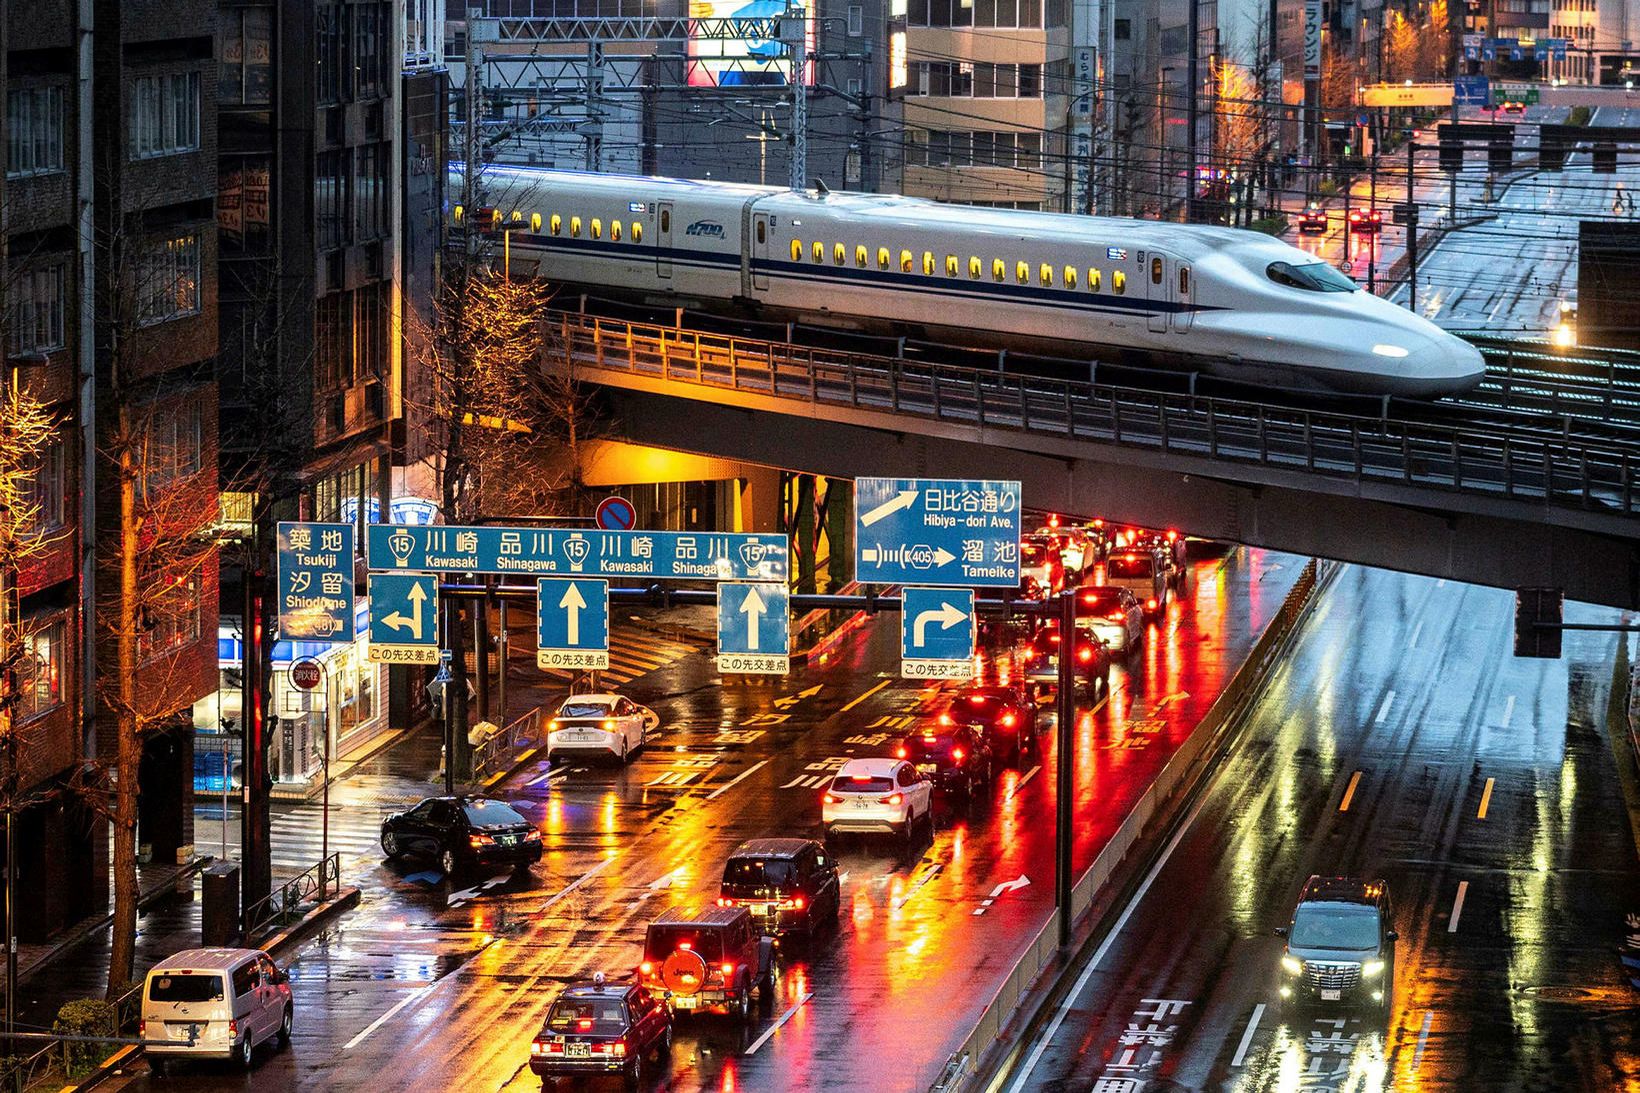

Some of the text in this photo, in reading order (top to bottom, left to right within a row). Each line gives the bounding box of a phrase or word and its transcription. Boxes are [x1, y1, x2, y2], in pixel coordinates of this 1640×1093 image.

[924, 488, 1016, 513] 日比谷通り
[990, 515, 1014, 529] Ave.
[289, 528, 343, 552] 築地
[393, 537, 409, 553] 15
[425, 530, 553, 556] 川崎 品川
[600, 535, 729, 560] 川崎 品川
[568, 542, 585, 558] 15
[743, 546, 761, 562] 15
[912, 551, 932, 564] 405
[961, 540, 1017, 563] 溜池
[296, 553, 337, 568] Tsukiji
[425, 556, 557, 572] Kawasaki Shinagawa
[600, 560, 653, 573] Kawasaki
[962, 565, 1015, 579] Tameike
[290, 571, 343, 594] 汐留
[371, 648, 437, 661] この先交差点
[540, 653, 607, 666] この先交差点
[720, 658, 787, 672] この先交差点
